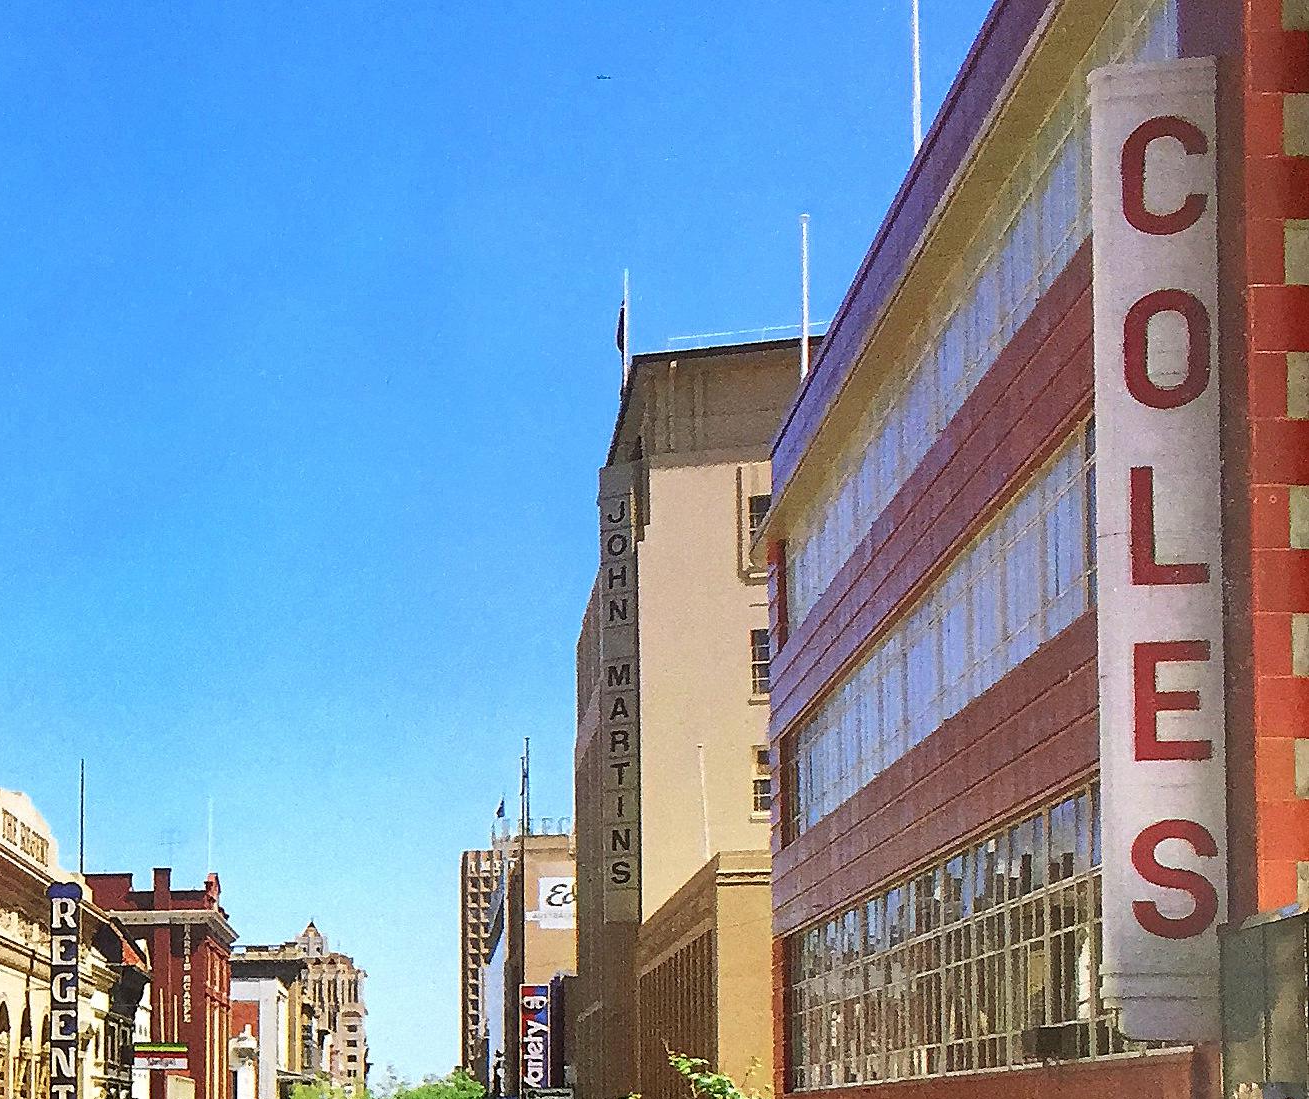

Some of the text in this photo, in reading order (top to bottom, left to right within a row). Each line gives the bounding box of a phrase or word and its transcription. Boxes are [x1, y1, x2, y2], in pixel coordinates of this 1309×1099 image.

[606, 500, 632, 885] JOHN MARTINS
[1120, 114, 1220, 941] COLES
